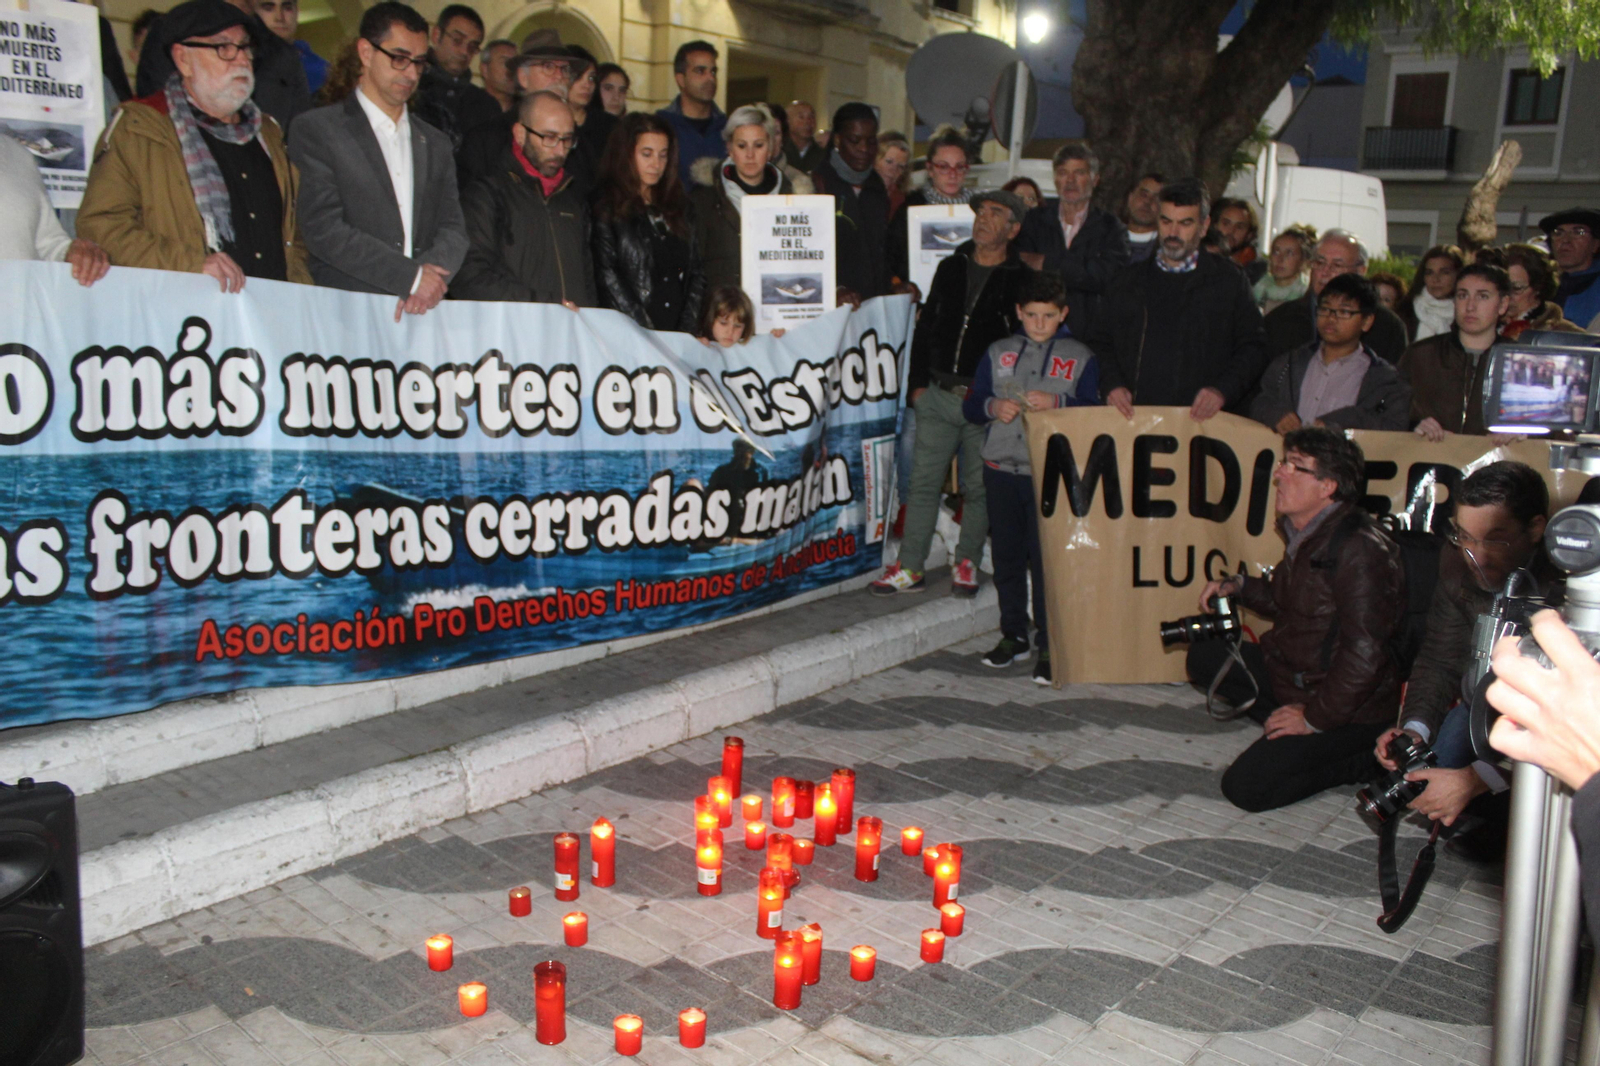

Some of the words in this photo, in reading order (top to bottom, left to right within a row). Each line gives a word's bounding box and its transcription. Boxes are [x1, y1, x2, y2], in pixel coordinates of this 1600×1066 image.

[0, 20, 20, 38] NO
[25, 21, 57, 43] MÁS
[0, 39, 62, 62] MUERTES
[13, 58, 31, 76] EN
[36, 61, 51, 78] EL
[0, 76, 84, 99] DITERRÁNEO
[775, 214, 788, 225] NO
[790, 211, 809, 225] MÁS
[772, 226, 812, 237] MUERTES
[781, 238, 792, 248] EN
[794, 238, 804, 248] EL
[758, 247, 825, 260] MEDITERRÁNEO
[1048, 355, 1078, 381] M
[0, 343, 55, 446] o
[70, 316, 266, 443] más
[279, 348, 582, 440] muertes
[593, 365, 682, 436] en
[84, 488, 455, 601] fronteras
[463, 468, 734, 566] cerradas
[195, 604, 406, 663] Asociación
[413, 601, 468, 642] Pro
[474, 585, 608, 633] Derechos
[614, 573, 736, 613] Humanos
[741, 560, 767, 592] de
